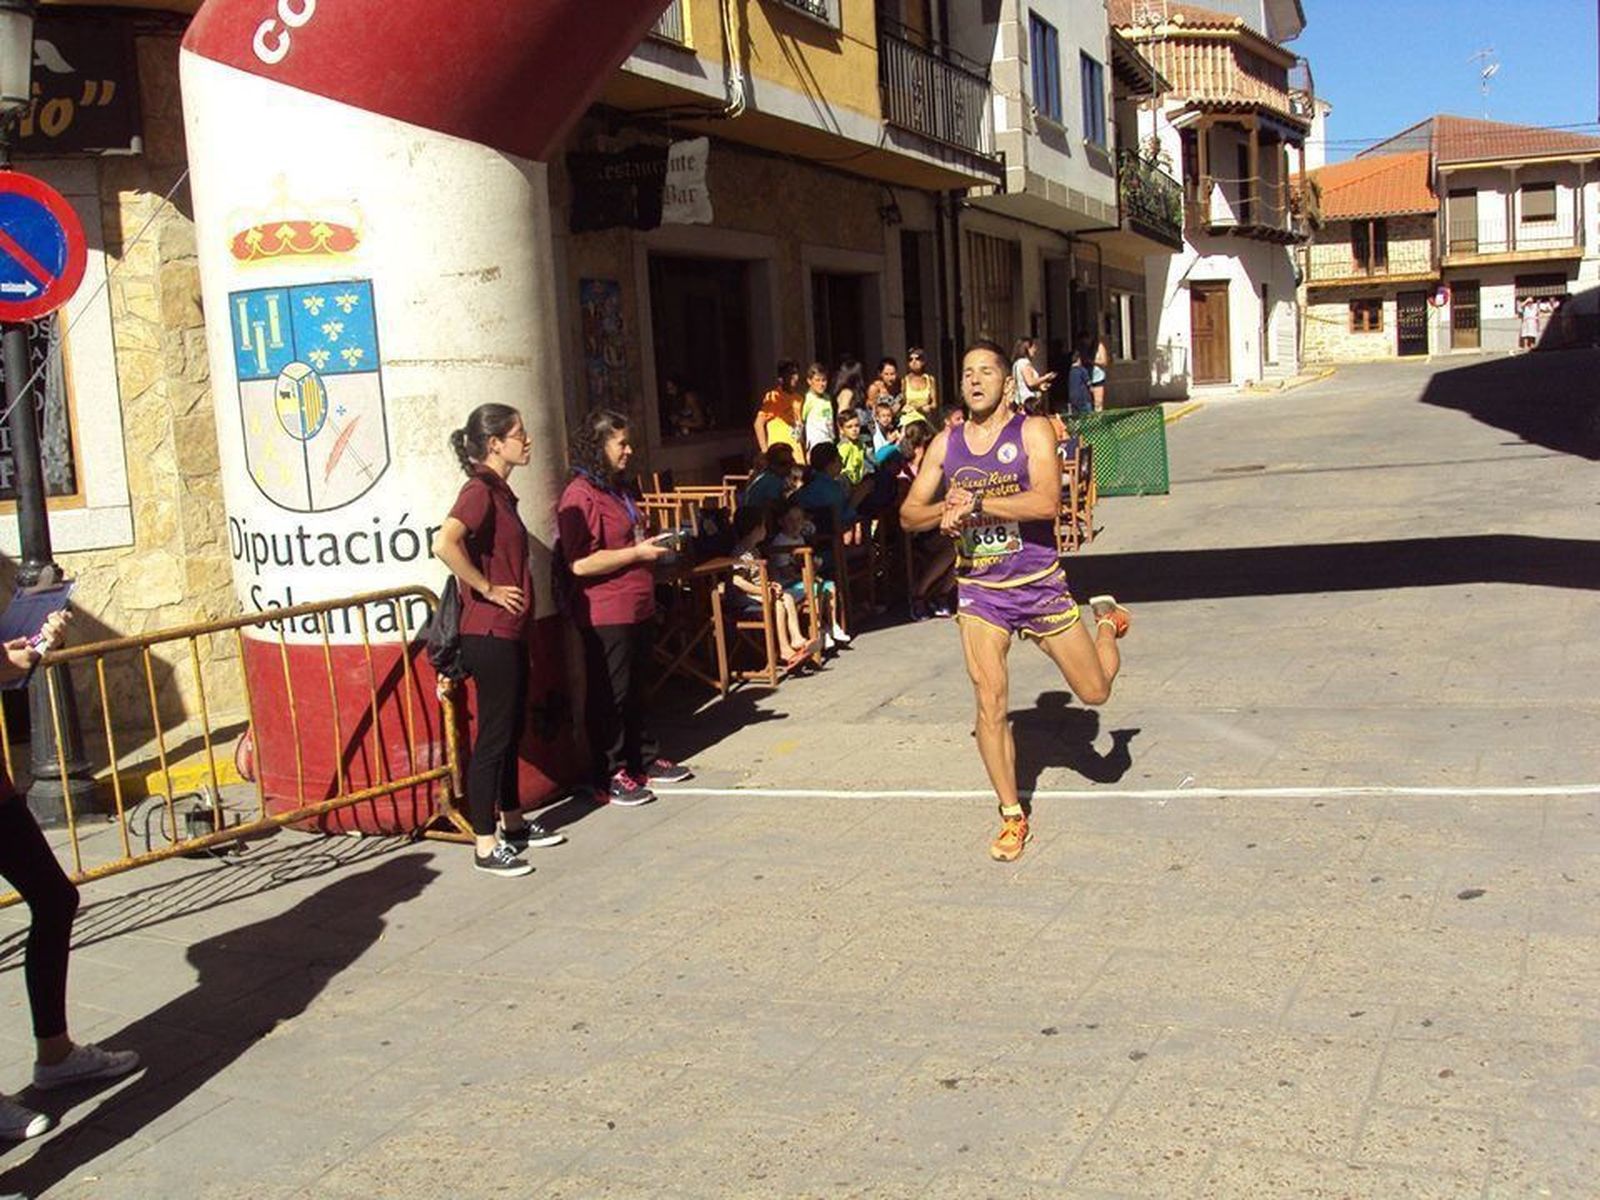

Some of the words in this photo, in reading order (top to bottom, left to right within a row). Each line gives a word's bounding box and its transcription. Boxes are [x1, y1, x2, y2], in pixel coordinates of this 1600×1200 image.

[660, 185, 698, 206] Bar
[229, 512, 442, 575] Diputación
[972, 526, 1008, 545] 668
[250, 585, 433, 634] Salaman
